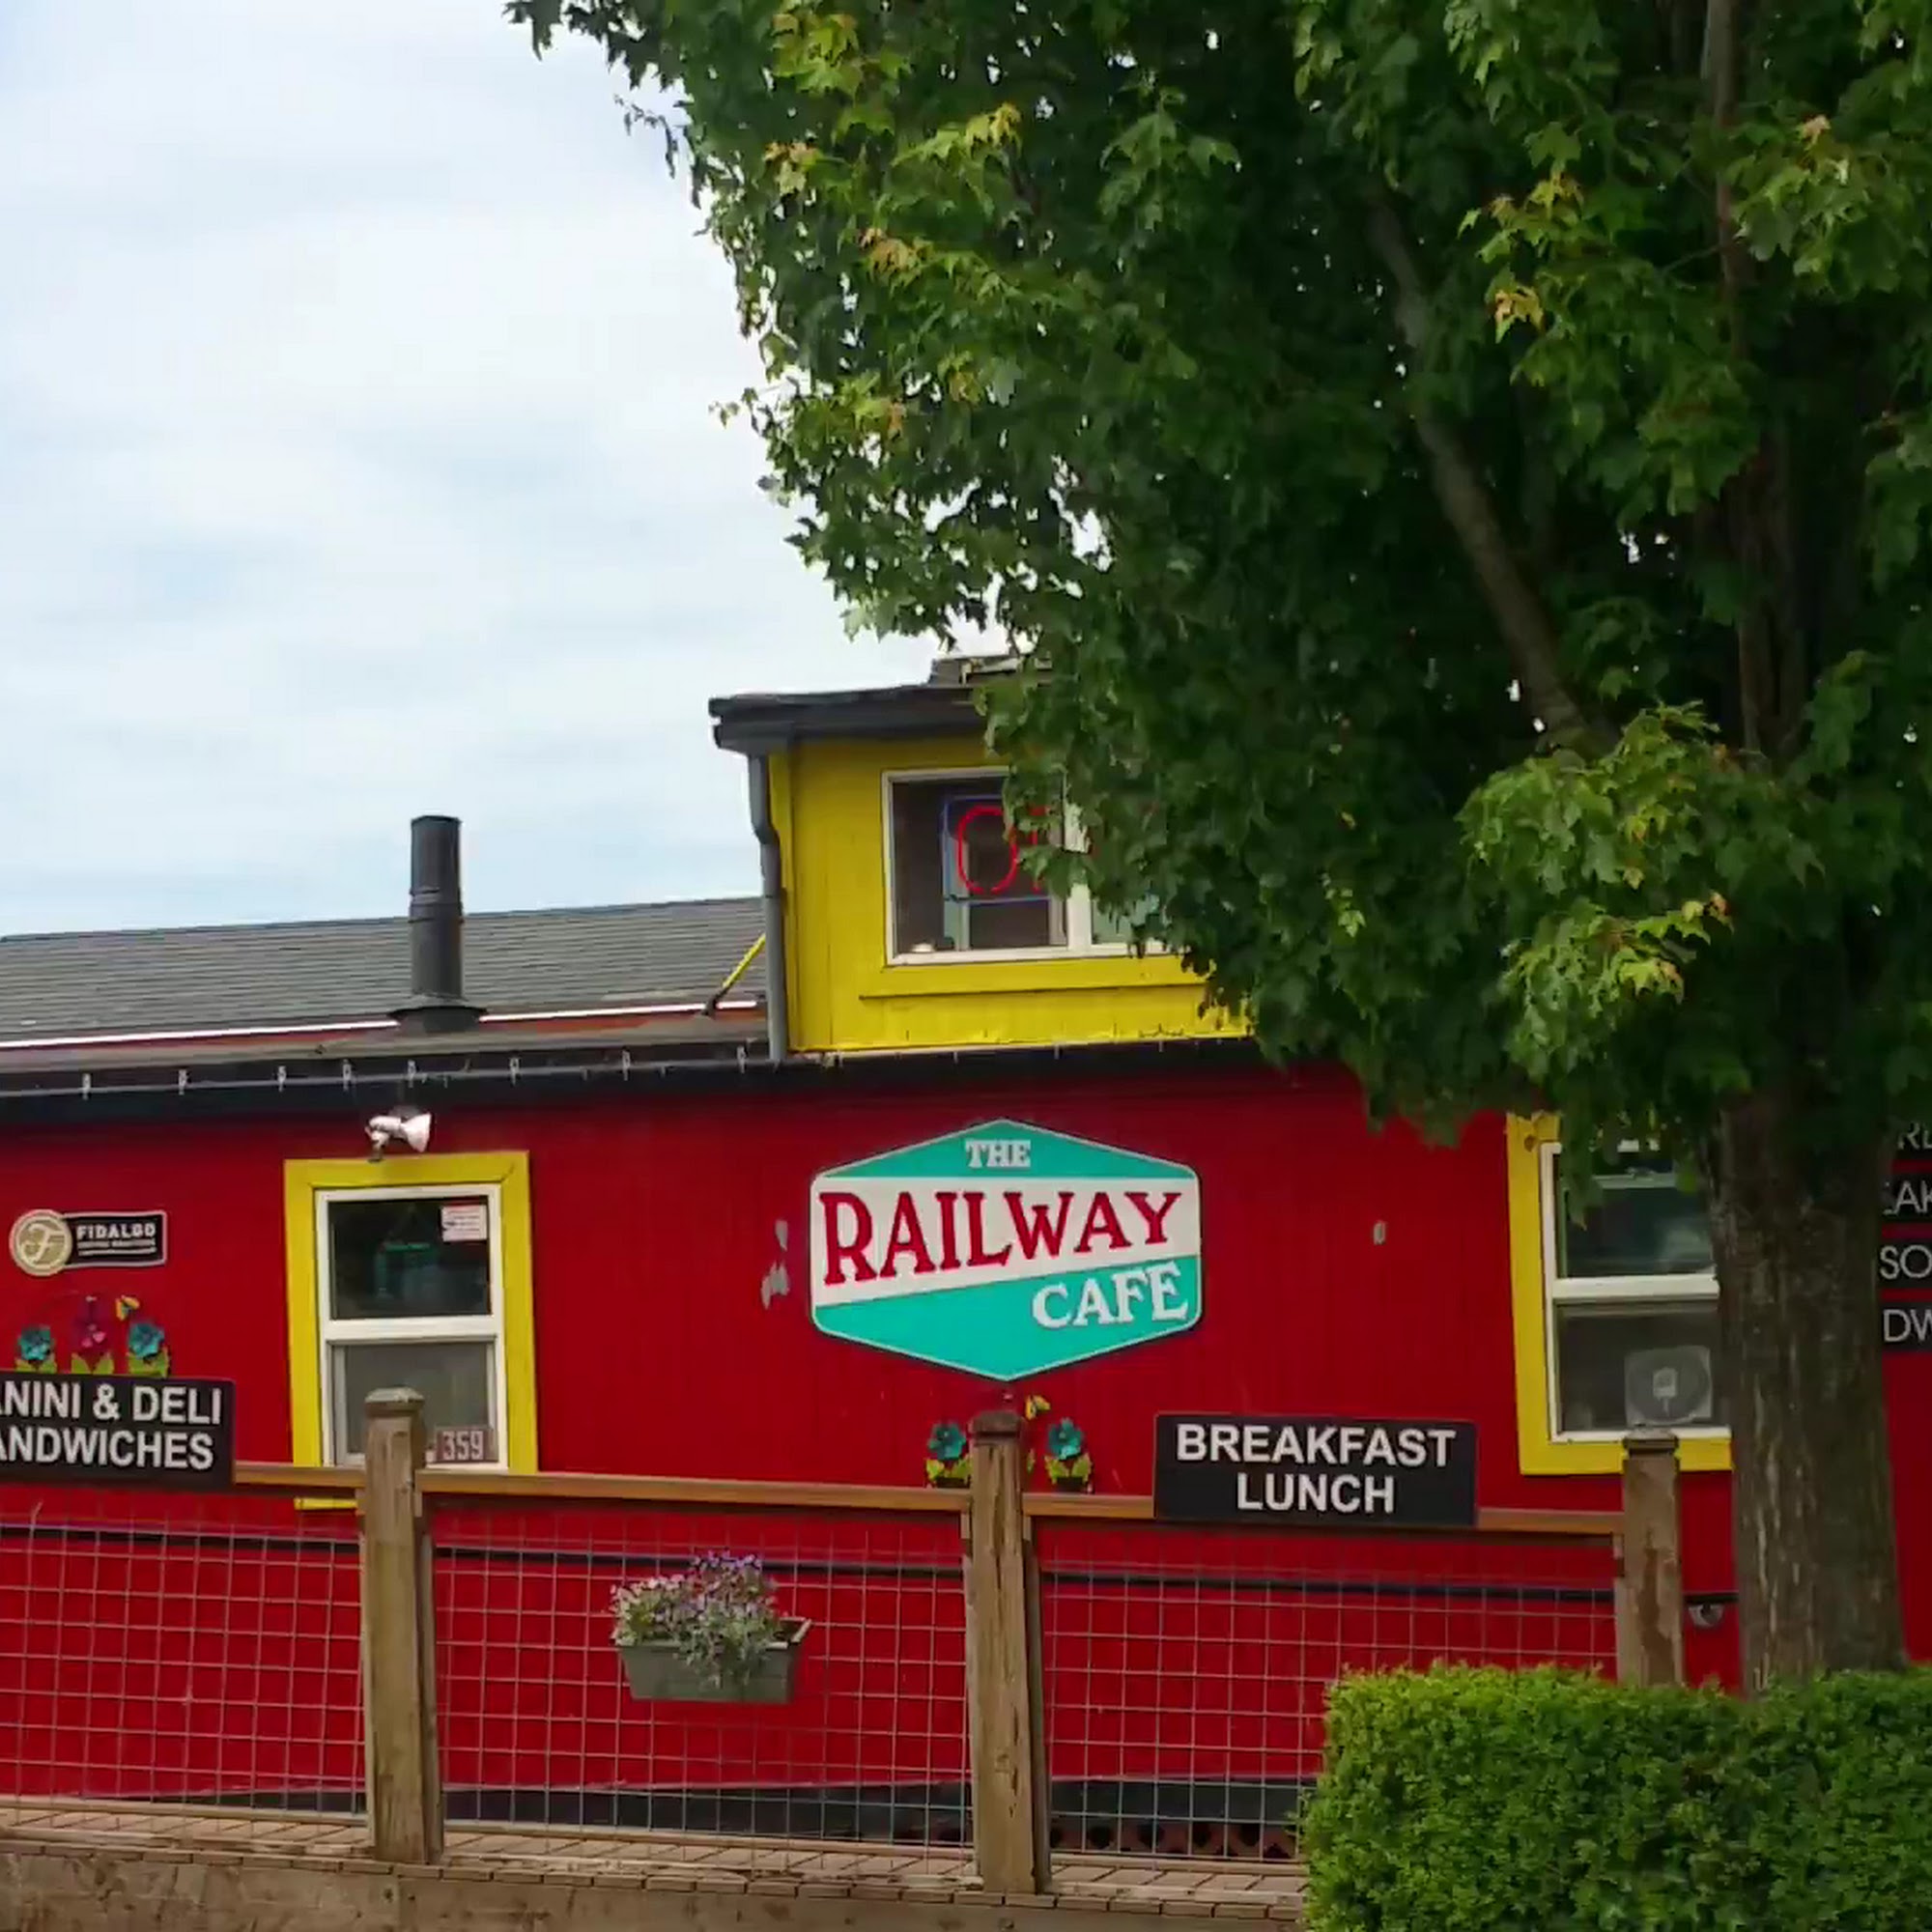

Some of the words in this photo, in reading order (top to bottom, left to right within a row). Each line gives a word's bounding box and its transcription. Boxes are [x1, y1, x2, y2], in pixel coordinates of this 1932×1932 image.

[965, 1139, 1032, 1169] THE
[76, 1222, 156, 1240] FIDALGO
[818, 1190, 1182, 1287] RAILWAY
[1032, 1261, 1189, 1329] CAFE
[0, 1380, 81, 1418] NINI
[93, 1382, 121, 1422] &
[132, 1385, 222, 1425] DELI
[442, 1430, 484, 1461] 359
[1176, 1423, 1457, 1467] BREAKFAST
[1236, 1472, 1396, 1514] LUNCH
